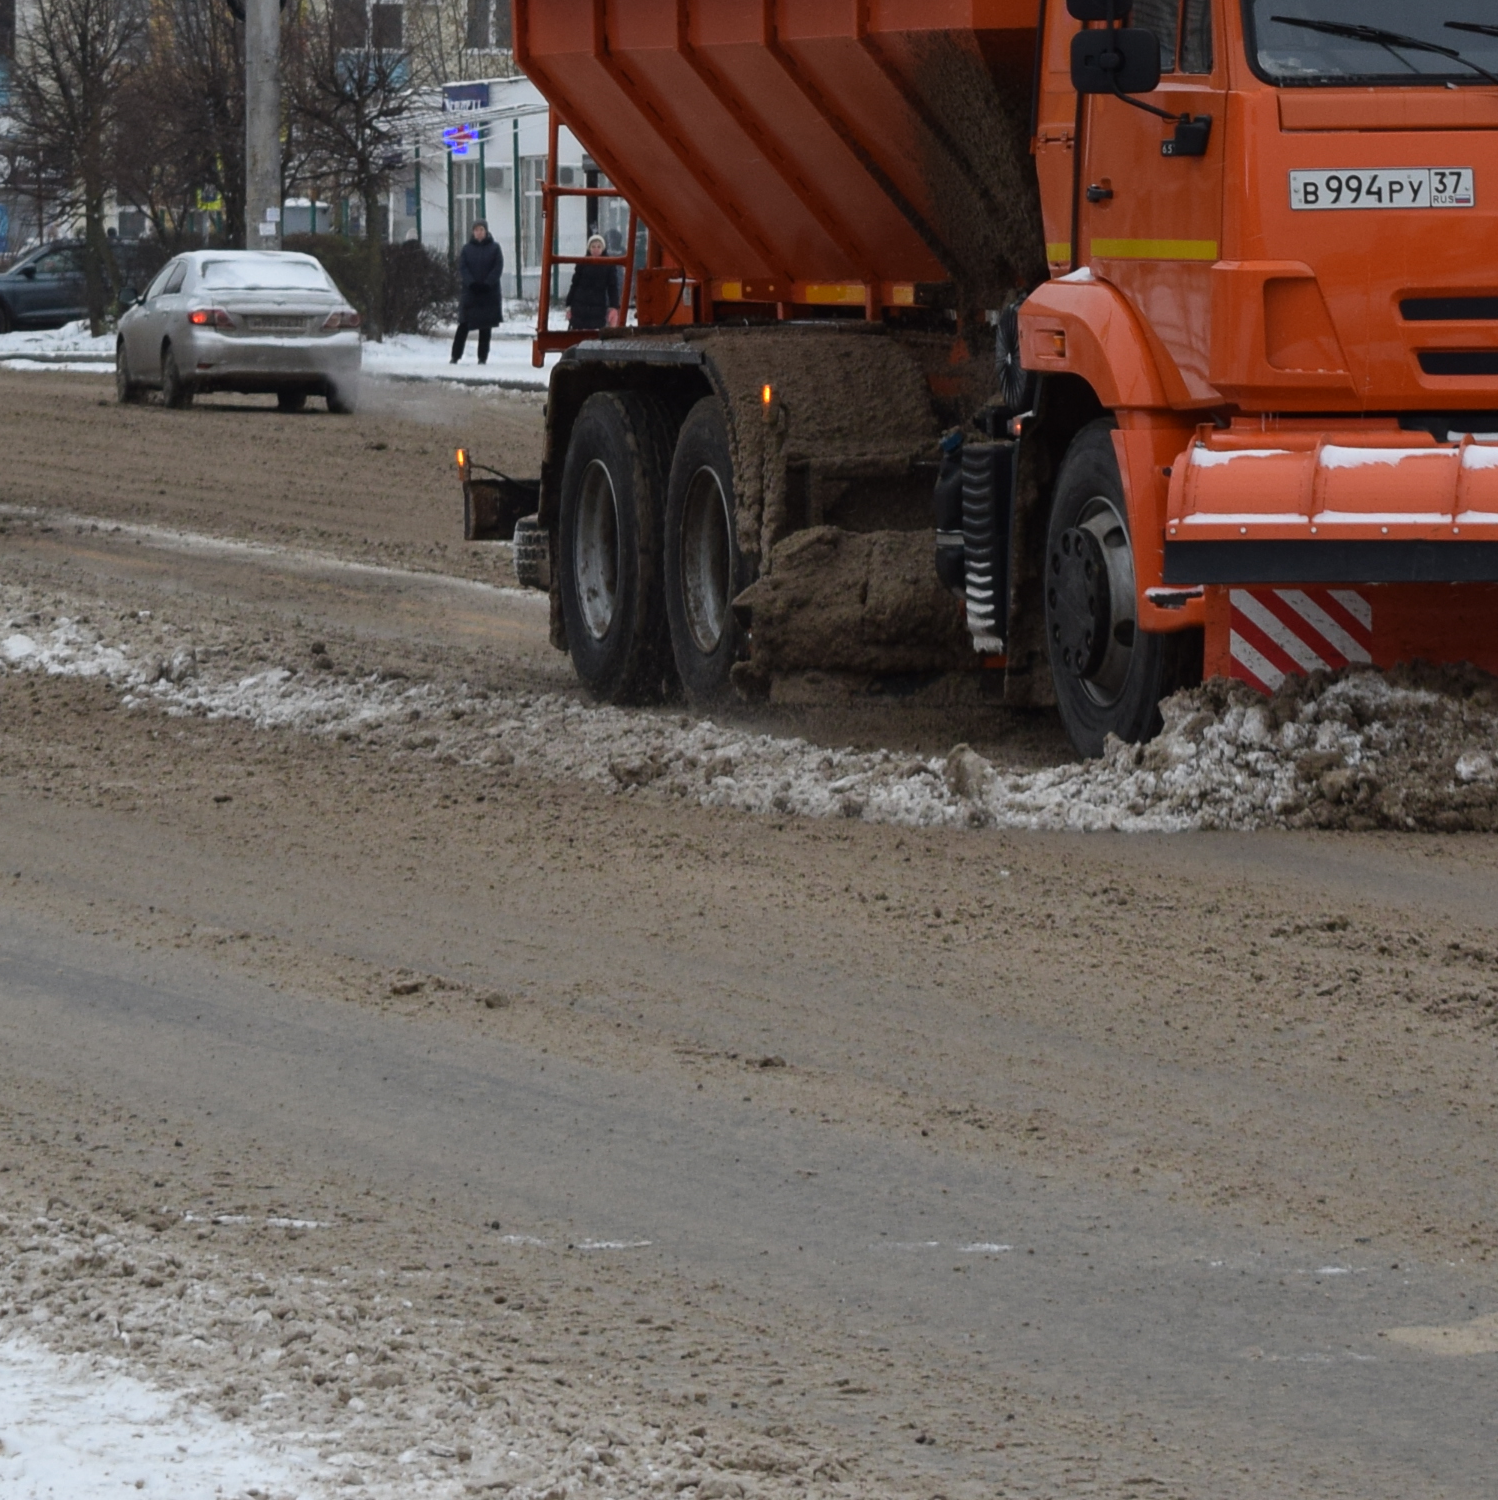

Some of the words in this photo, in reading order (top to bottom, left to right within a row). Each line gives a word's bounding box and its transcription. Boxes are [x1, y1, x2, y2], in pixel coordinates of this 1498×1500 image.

[1303, 174, 1423, 204] В994РУ
[1433, 171, 1462, 194] 37
[1432, 194, 1455, 204] RUS
